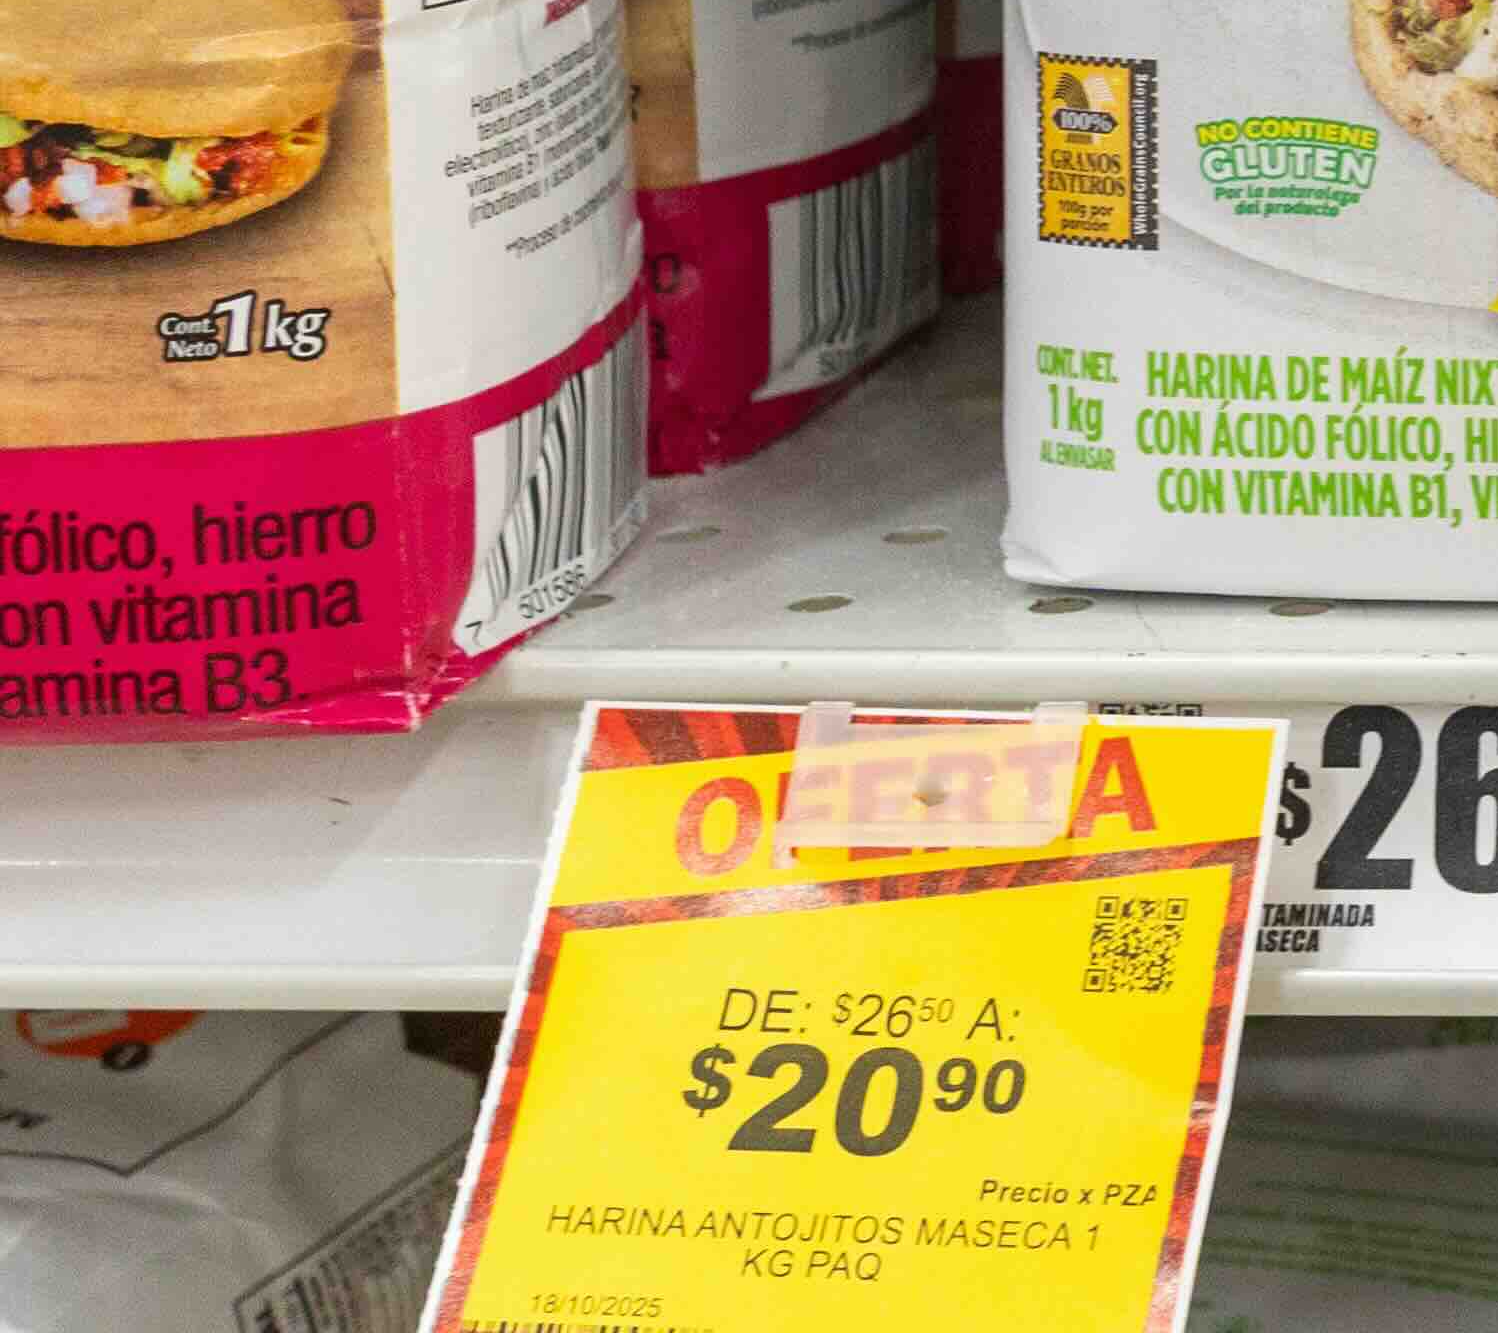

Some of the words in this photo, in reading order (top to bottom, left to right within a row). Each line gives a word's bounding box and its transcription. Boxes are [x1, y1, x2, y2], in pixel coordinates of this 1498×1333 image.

[160, 317, 216, 336] Cont.
[167, 340, 218, 358] Neto
[264, 303, 329, 357] kg
[193, 501, 376, 565] hierro
[89, 573, 363, 644] vitamina
[518, 567, 586, 621] 501586
[718, 988, 809, 1036] DE:
[967, 998, 1021, 1042] A:
[978, 1179, 1070, 1206] Precio
[1079, 1186, 1094, 1206] x
[1104, 1183, 1158, 1208] PZA
[546, 1205, 687, 1237] HARINA
[696, 1212, 904, 1246] ANTOJITOS
[915, 1217, 1073, 1251] MASECA
[1087, 1224, 1101, 1251] 1
[741, 1248, 795, 1277] KG
[806, 1250, 883, 1283] PAQ
[529, 1292, 663, 1319] 18/10/2025
